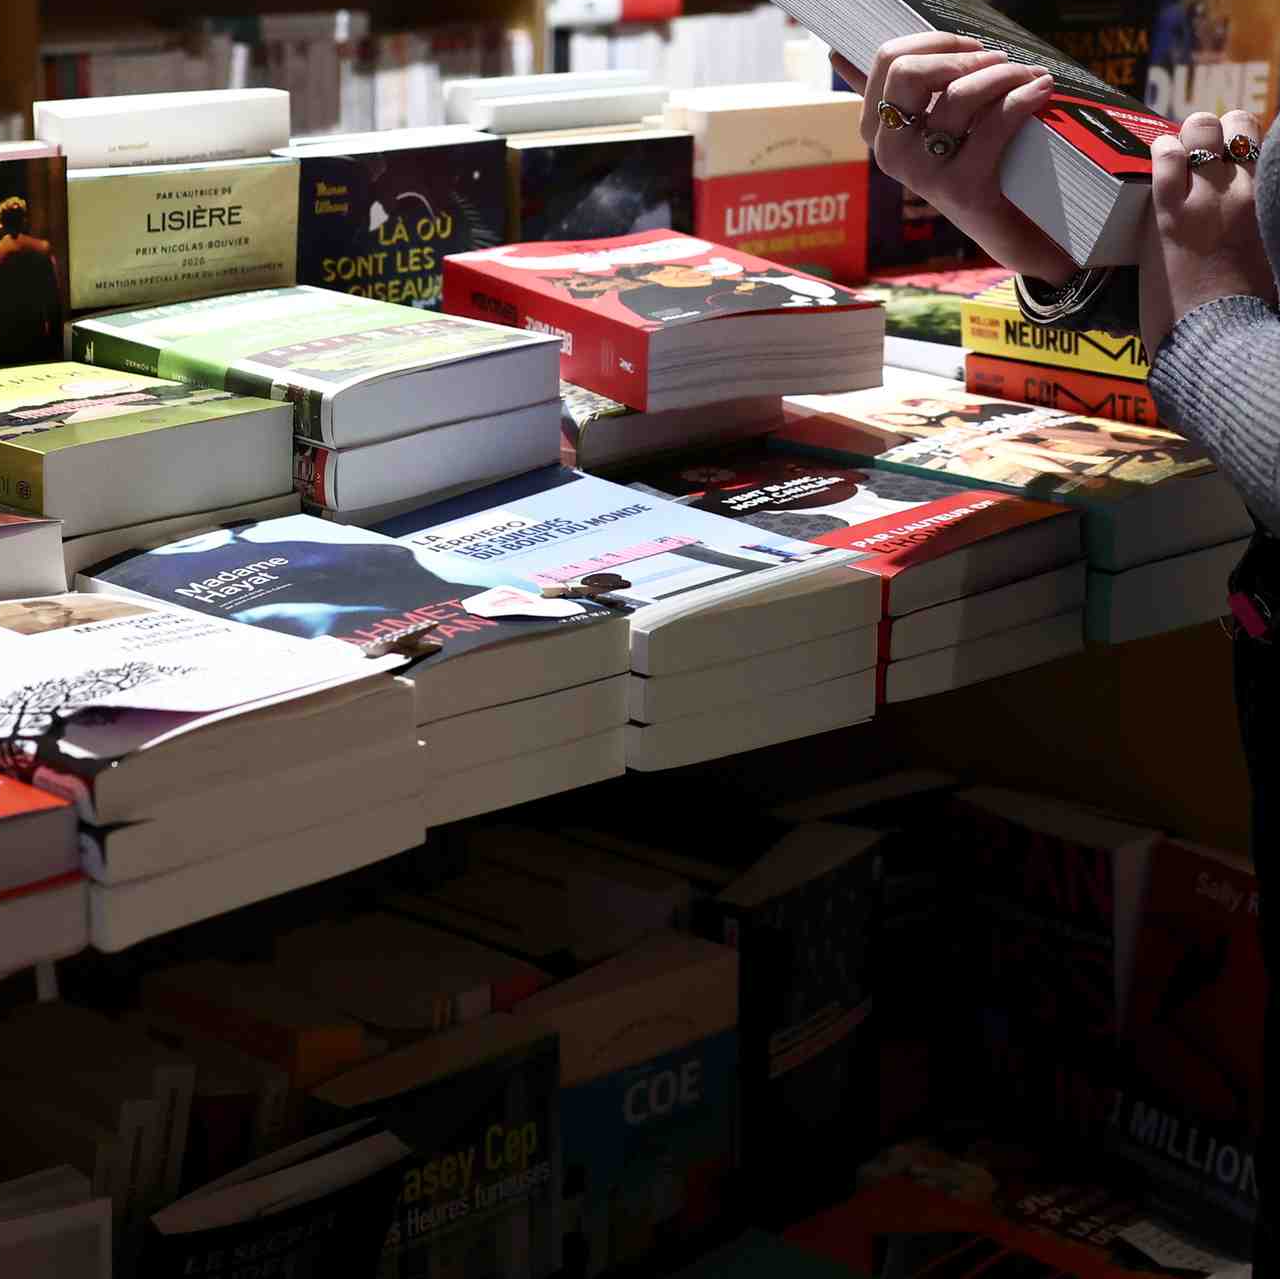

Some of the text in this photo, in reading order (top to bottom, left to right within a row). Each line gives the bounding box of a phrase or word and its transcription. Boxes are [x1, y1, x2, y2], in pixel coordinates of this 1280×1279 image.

[147, 205, 243, 233] LISIÈRE
[725, 194, 851, 237] LINDSTEDT
[322, 247, 435, 282] SONT LES
[1004, 319, 1149, 367] NEUROMA
[502, 531, 558, 554] BOUT
[560, 522, 587, 536] DU
[588, 503, 654, 527] MONDE
[851, 532, 891, 549] PAR
[892, 508, 970, 537] L'AUTEUR
[174, 555, 290, 598] Madame
[194, 570, 281, 605] Hayat
[622, 1057, 705, 1126] COE
[401, 1119, 540, 1203] asey Cep
